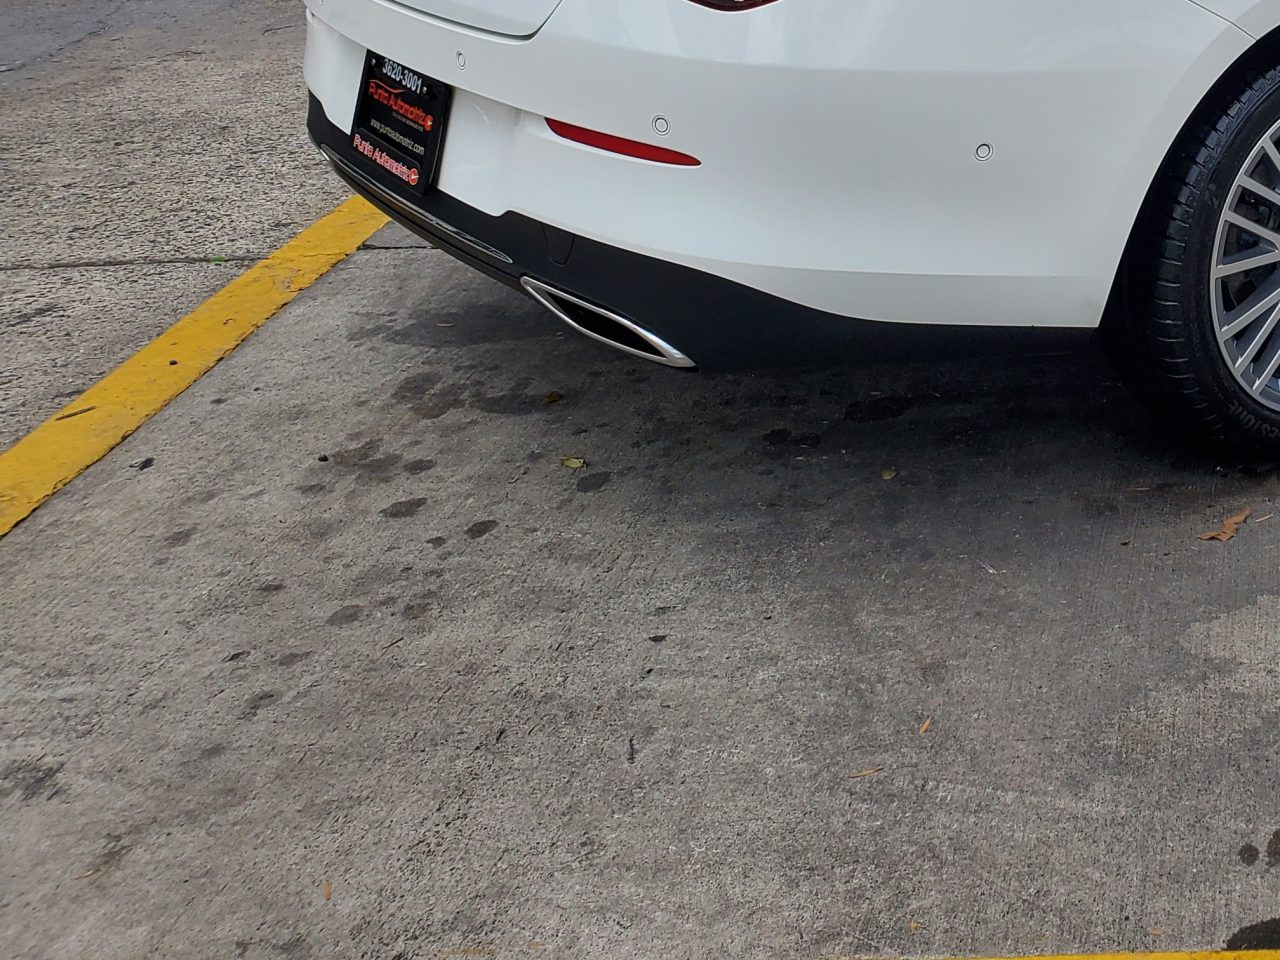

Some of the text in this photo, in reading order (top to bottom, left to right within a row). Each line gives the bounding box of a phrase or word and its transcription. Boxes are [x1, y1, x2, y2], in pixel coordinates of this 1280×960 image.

[382, 58, 423, 94] 3620-3001
[353, 134, 411, 182] Punto Automotriz
